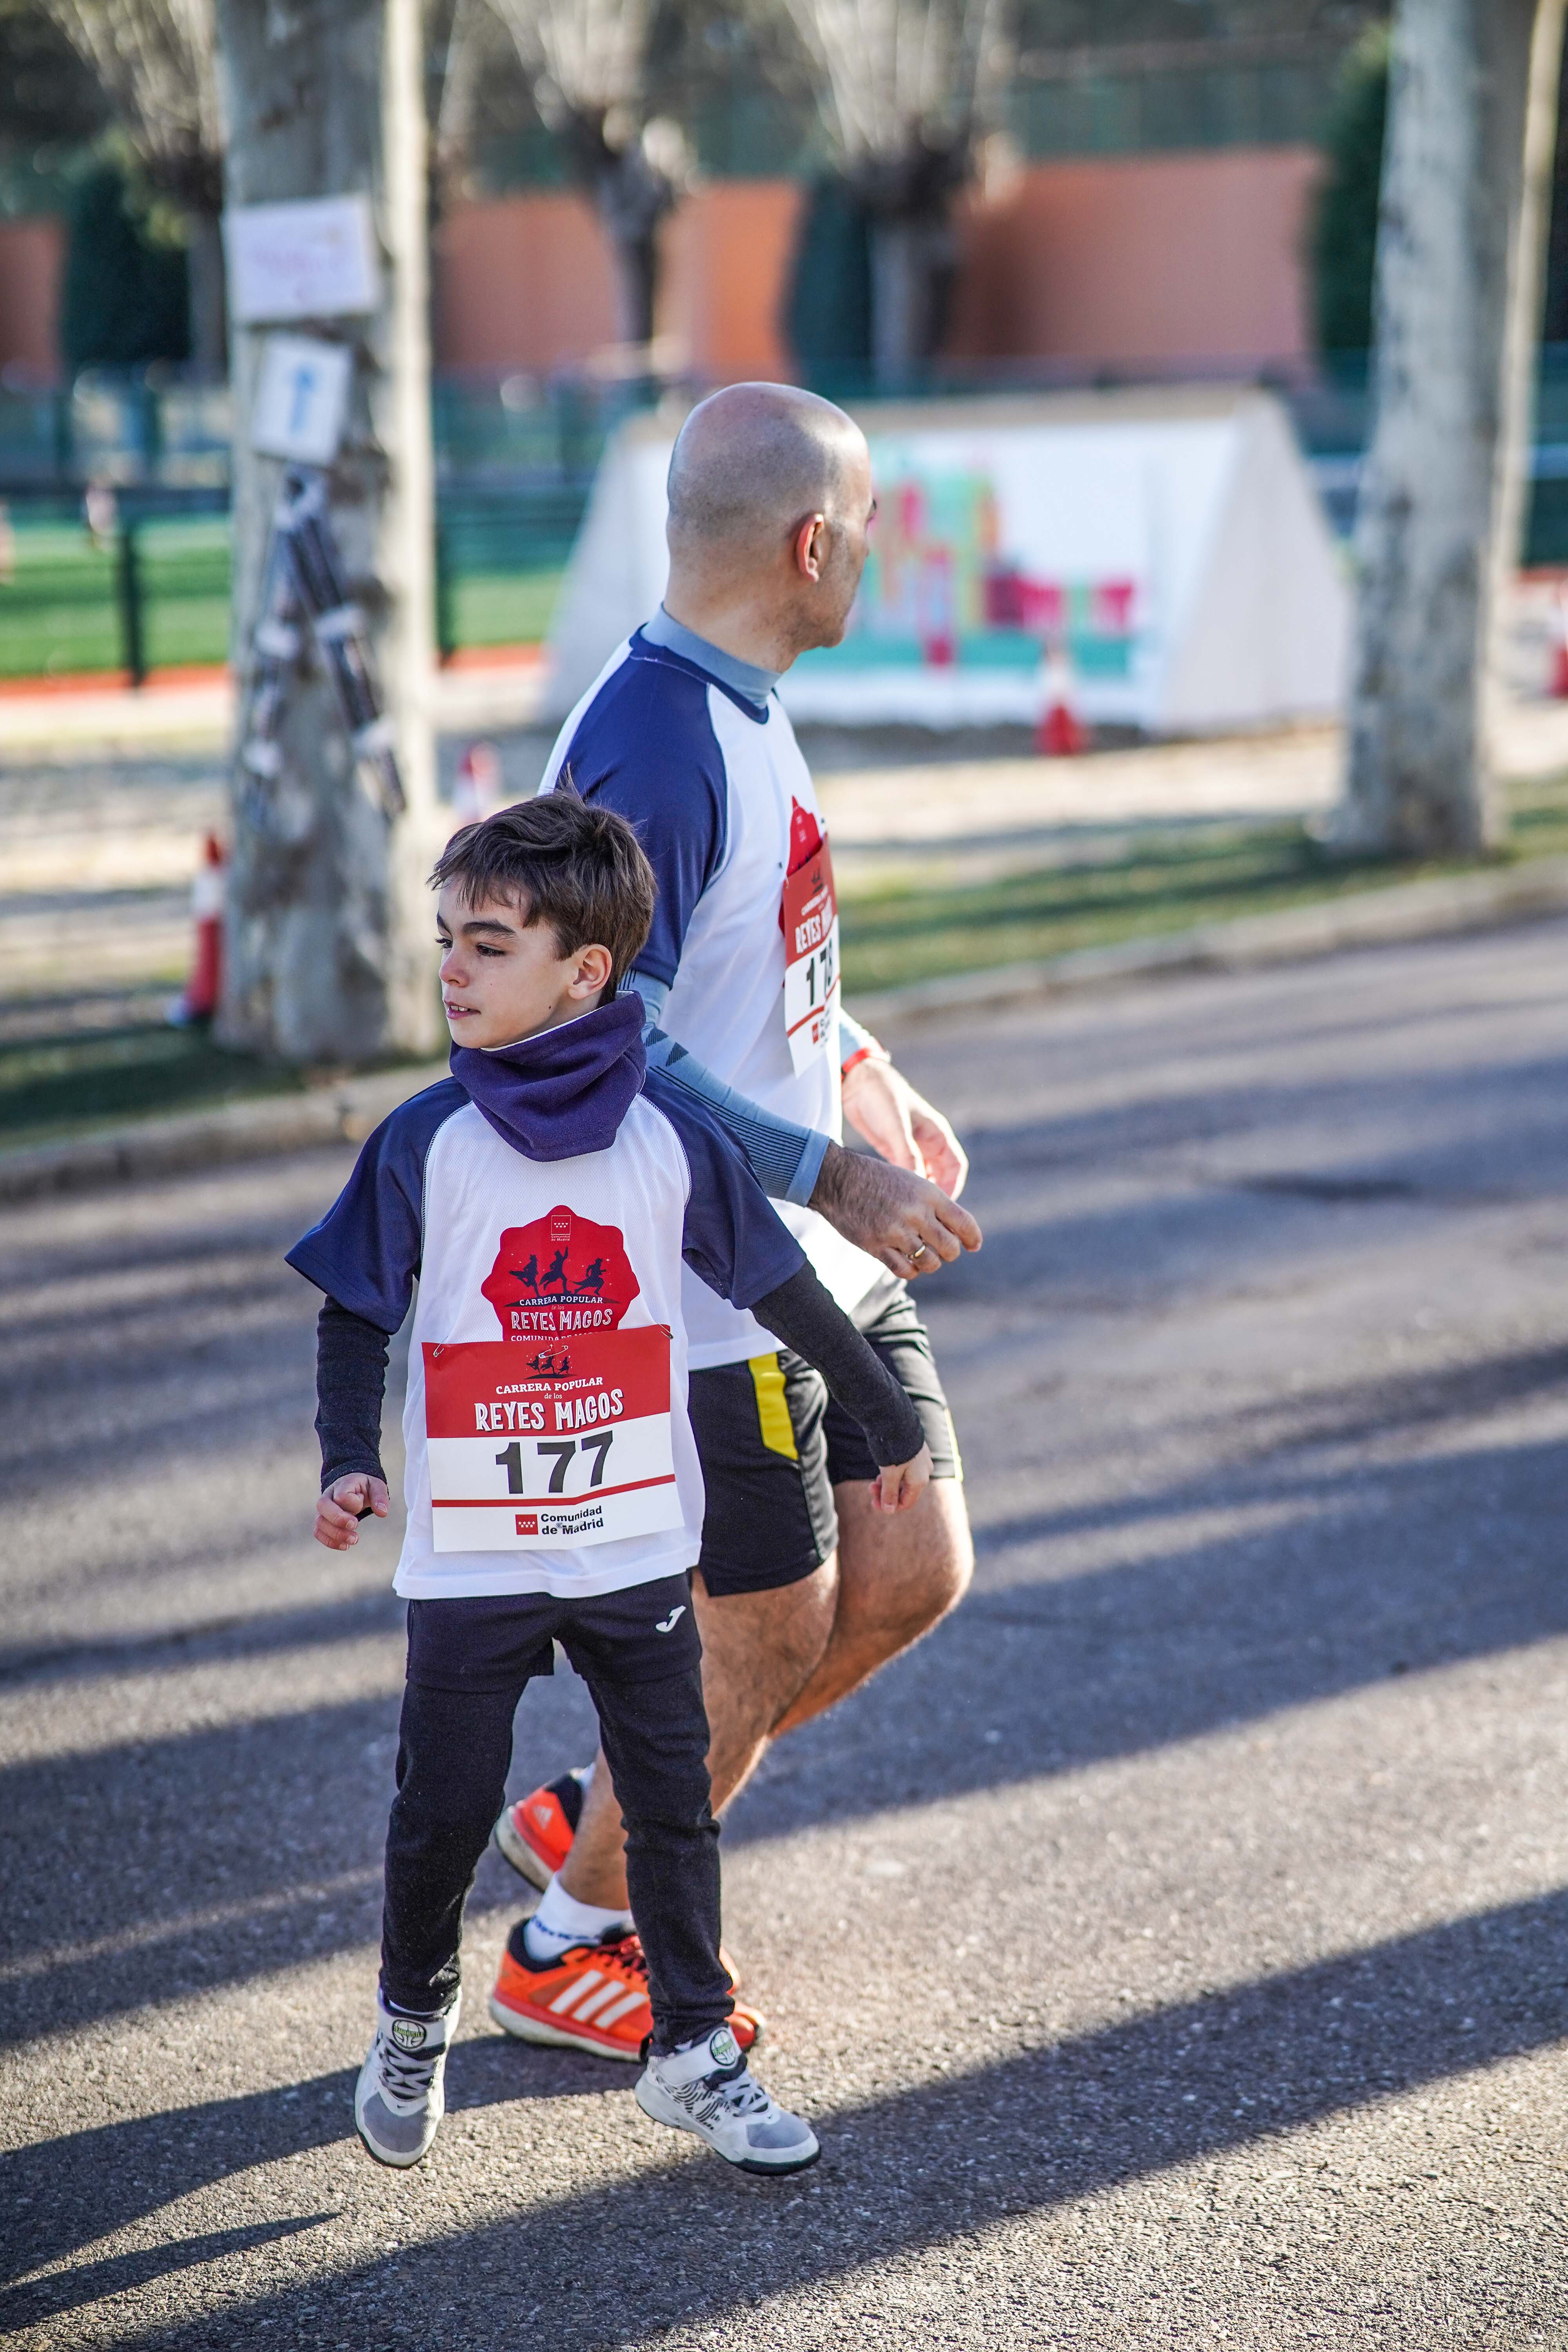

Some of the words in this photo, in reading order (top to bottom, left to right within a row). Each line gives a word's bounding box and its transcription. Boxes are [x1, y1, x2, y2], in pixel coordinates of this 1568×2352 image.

[519, 1296, 557, 1306] CARRERA
[511, 1311, 556, 1331] REYES
[559, 1309, 613, 1330] MAGOS
[496, 1383, 551, 1394] CARRERA
[554, 1377, 603, 1391] POPULAR
[474, 1401, 545, 1432] REYES
[554, 1388, 624, 1431] MAGOS
[495, 1430, 613, 1494] 177
[541, 1506, 602, 1522] Comunidad
[542, 1526, 557, 1535] de
[563, 1518, 603, 1534] Madrid
